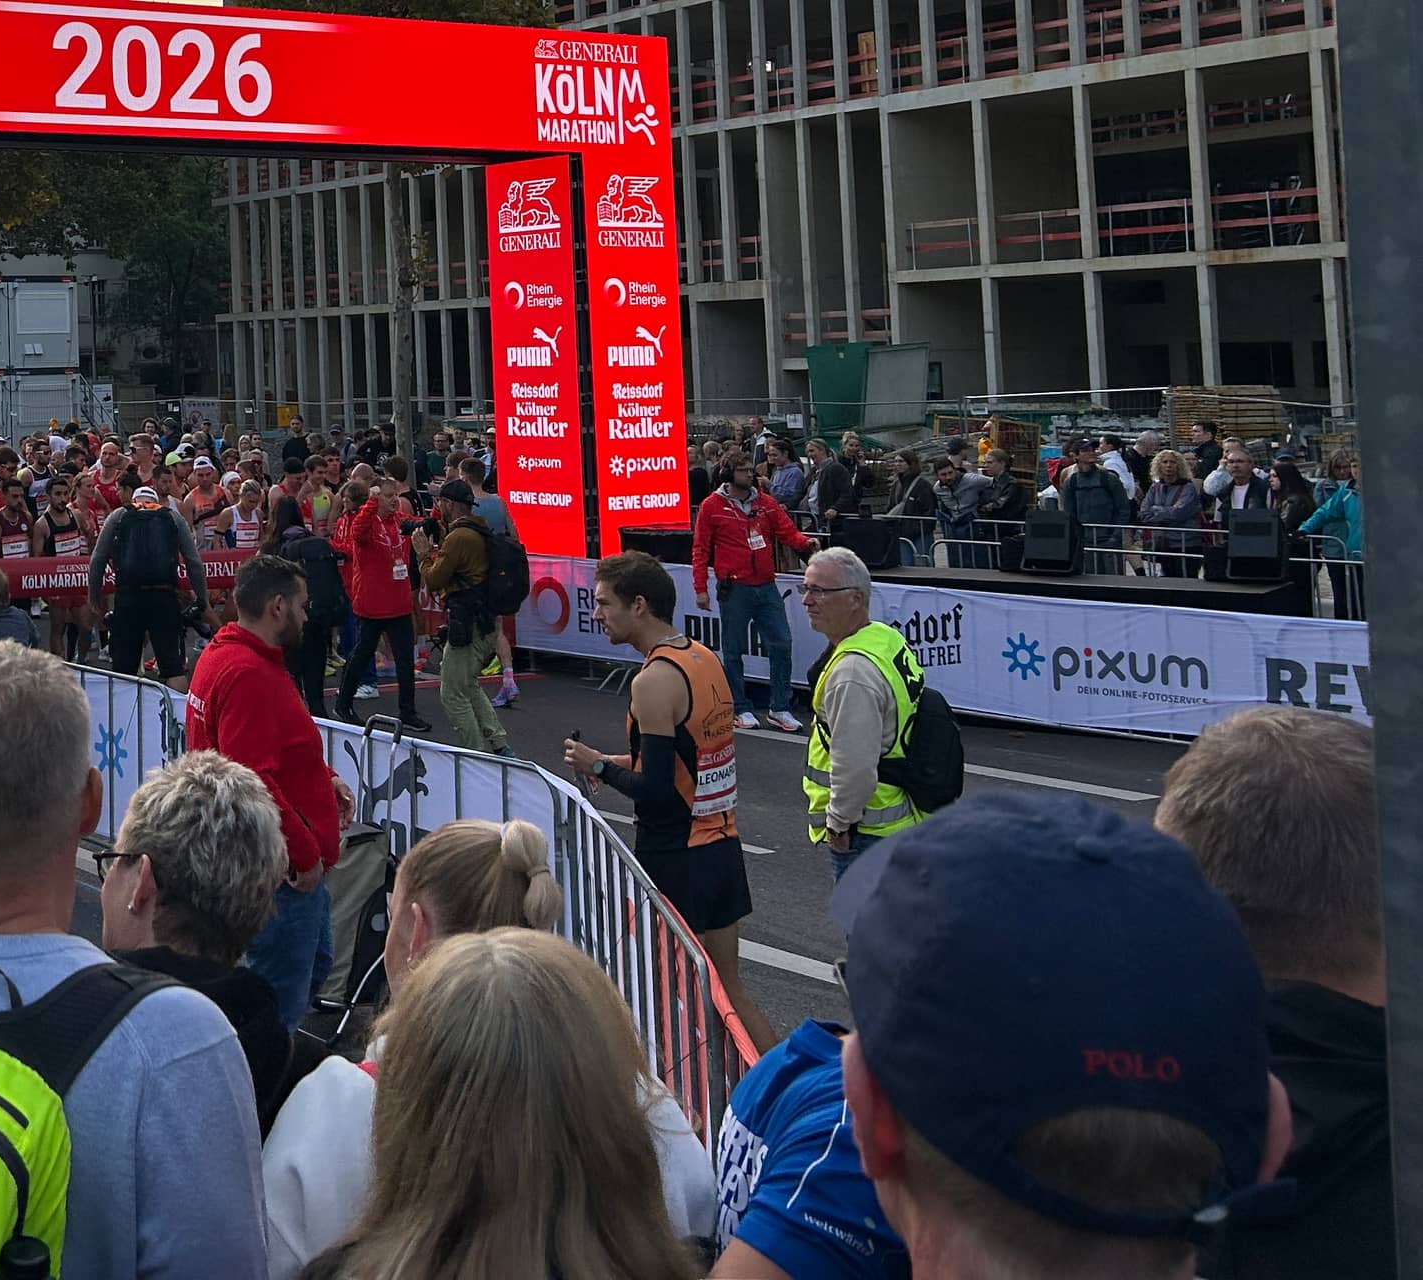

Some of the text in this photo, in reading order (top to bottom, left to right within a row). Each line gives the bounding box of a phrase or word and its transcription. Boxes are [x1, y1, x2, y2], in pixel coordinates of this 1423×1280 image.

[560, 40, 638, 64] GENERALI
[52, 21, 273, 117] 2026
[535, 63, 614, 115] KÖLN
[537, 118, 616, 145] MARATHON
[499, 231, 561, 253] GENERALI
[598, 230, 665, 248] GENERALI
[526, 284, 554, 297] Rhein
[628, 281, 657, 294] Rhein
[526, 295, 564, 310] Energie
[628, 293, 667, 308] Energie
[506, 346, 551, 367] PUMA
[607, 345, 655, 367] PUMA
[511, 382, 559, 399] Reissdorf
[612, 382, 663, 399] Reissdorf
[516, 402, 557, 417] Kölner
[617, 403, 662, 418] Kölner
[507, 417, 569, 438] Radler
[608, 418, 673, 440] Radler
[528, 456, 562, 470] pixum
[626, 455, 677, 478] pixum
[509, 490, 573, 508] REWE GROUP
[608, 492, 680, 511] REWE GROUP
[177, 560, 241, 579] GERAL
[21, 571, 89, 589] KÖLN MARATH
[1052, 646, 1209, 692] pixum
[1077, 685, 1100, 697] DEIN
[1083, 1048, 1182, 1082] POLO
